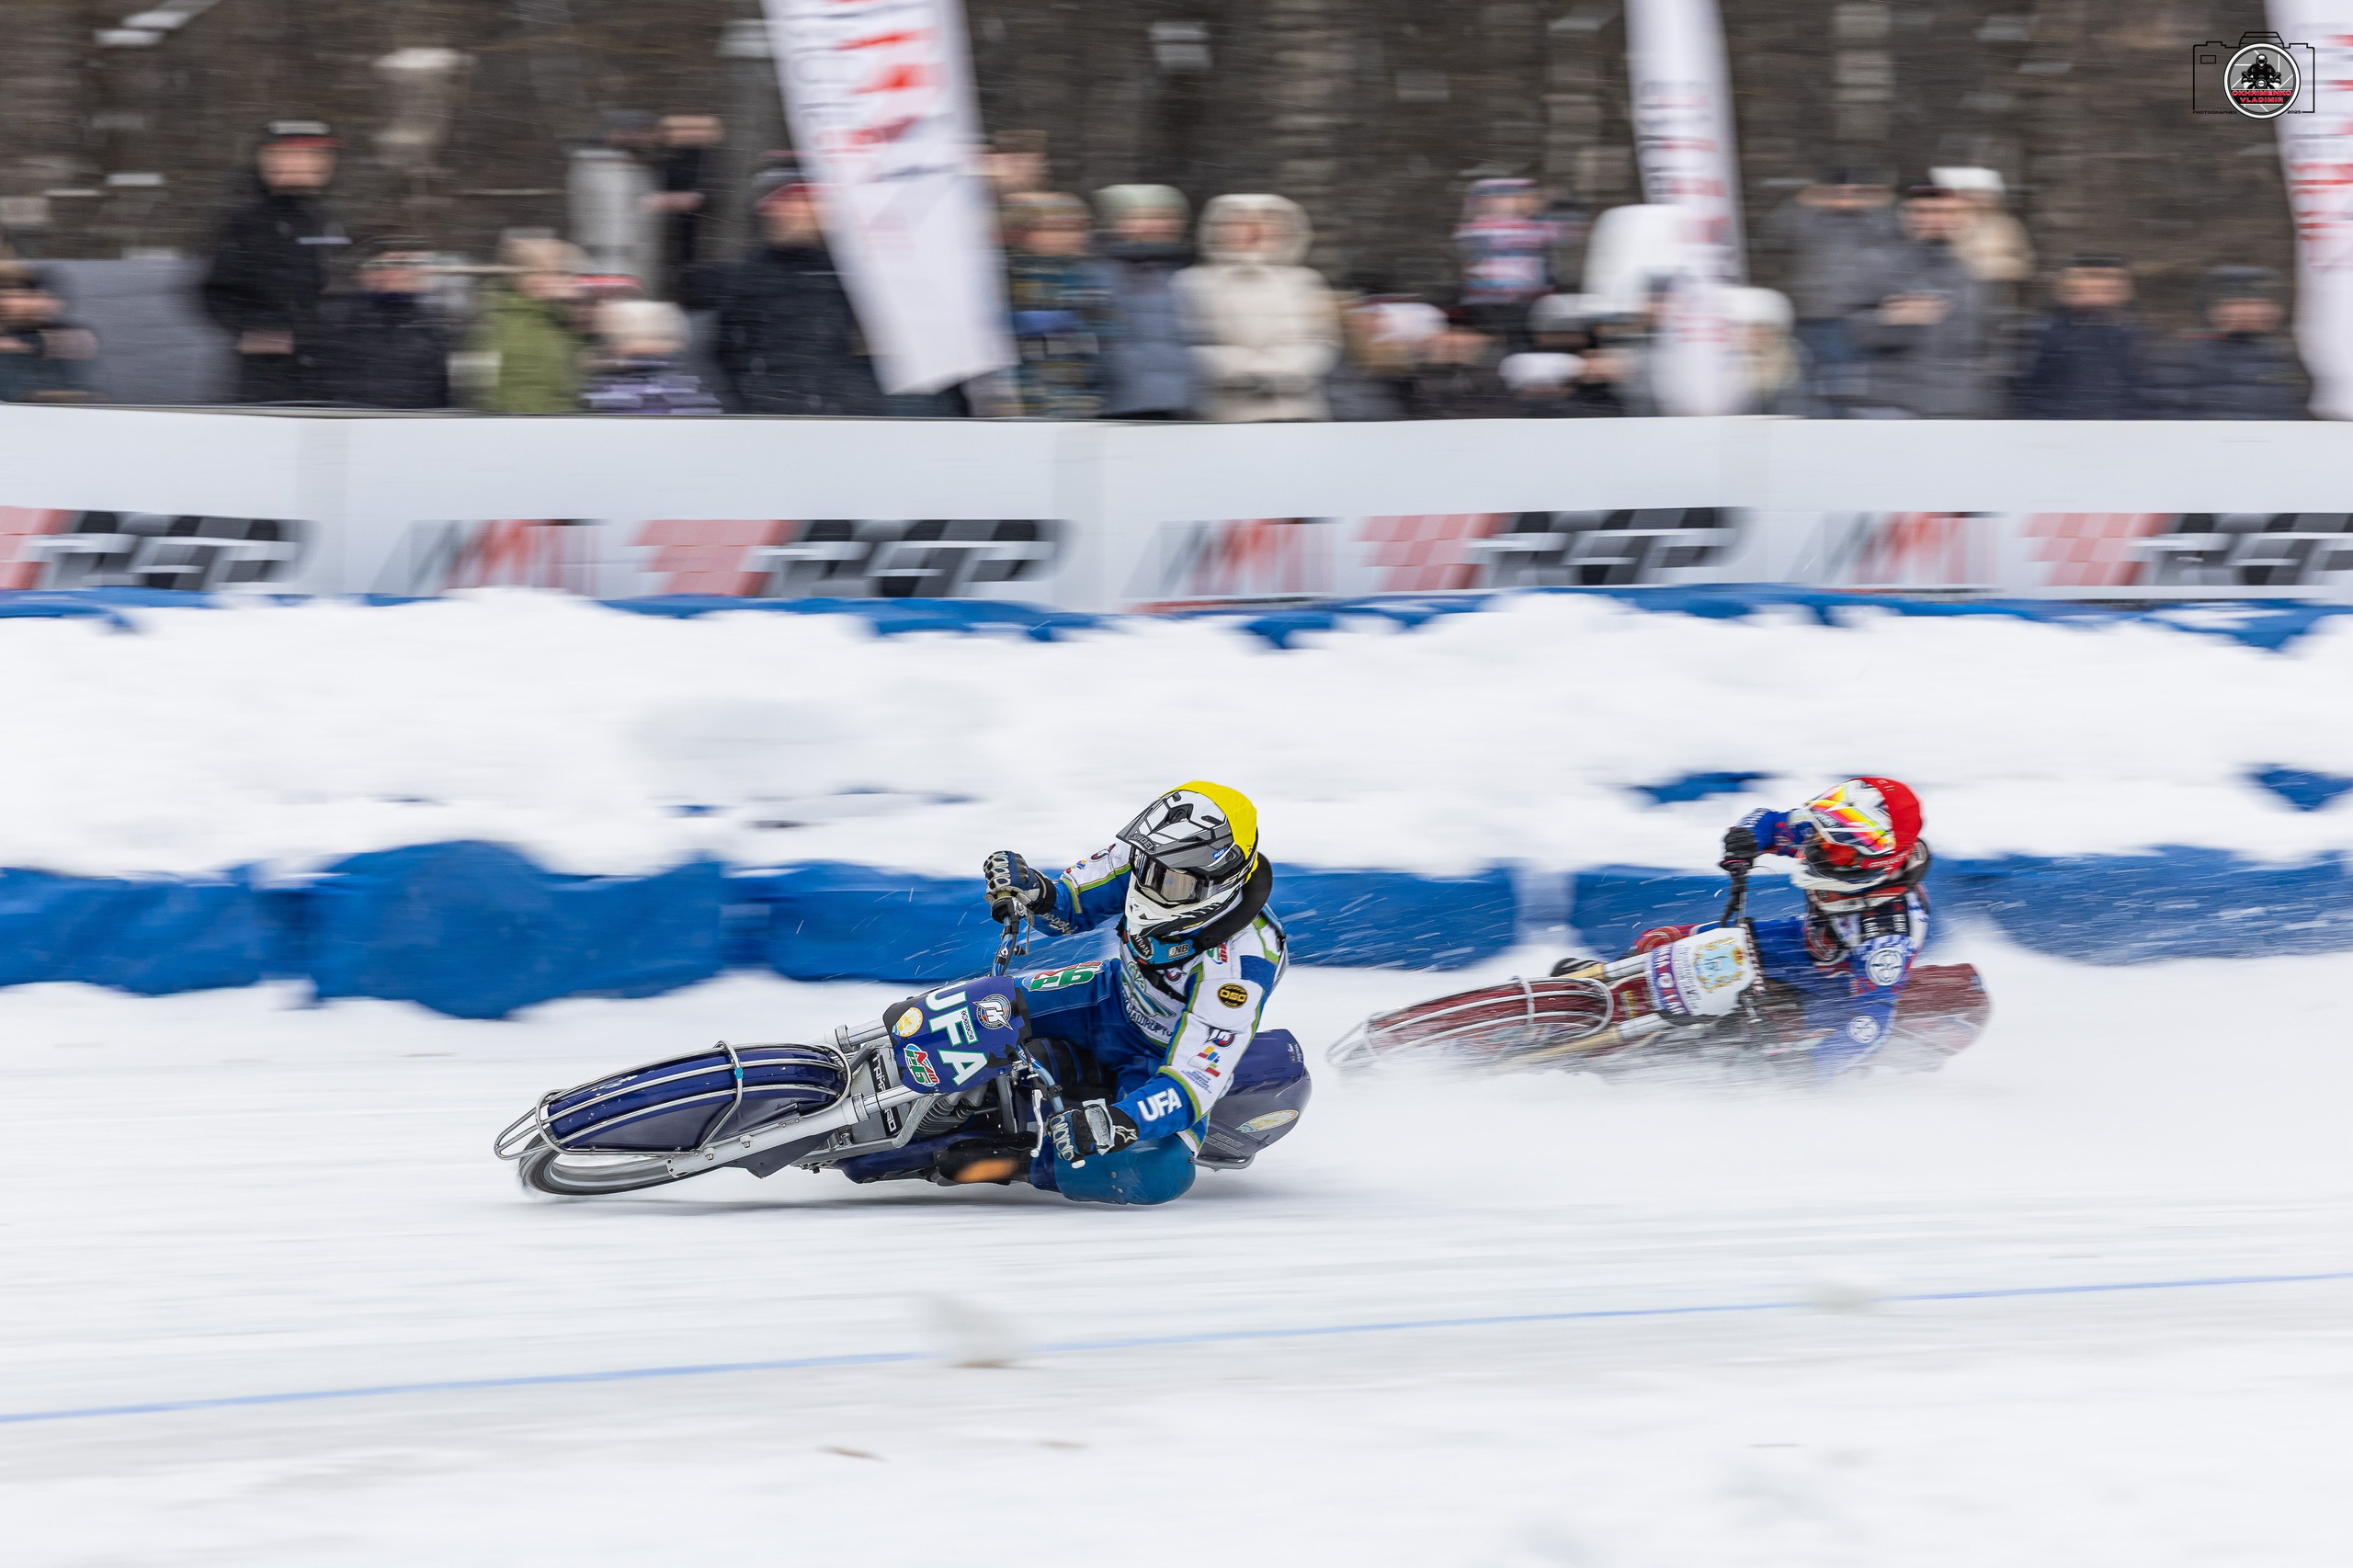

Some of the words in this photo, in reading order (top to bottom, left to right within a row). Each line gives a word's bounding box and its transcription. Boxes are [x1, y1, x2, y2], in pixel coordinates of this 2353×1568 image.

[1131, 834, 1154, 850] SHOEI
[925, 987, 987, 1086] UFA
[1137, 1087, 1182, 1122] UFA
